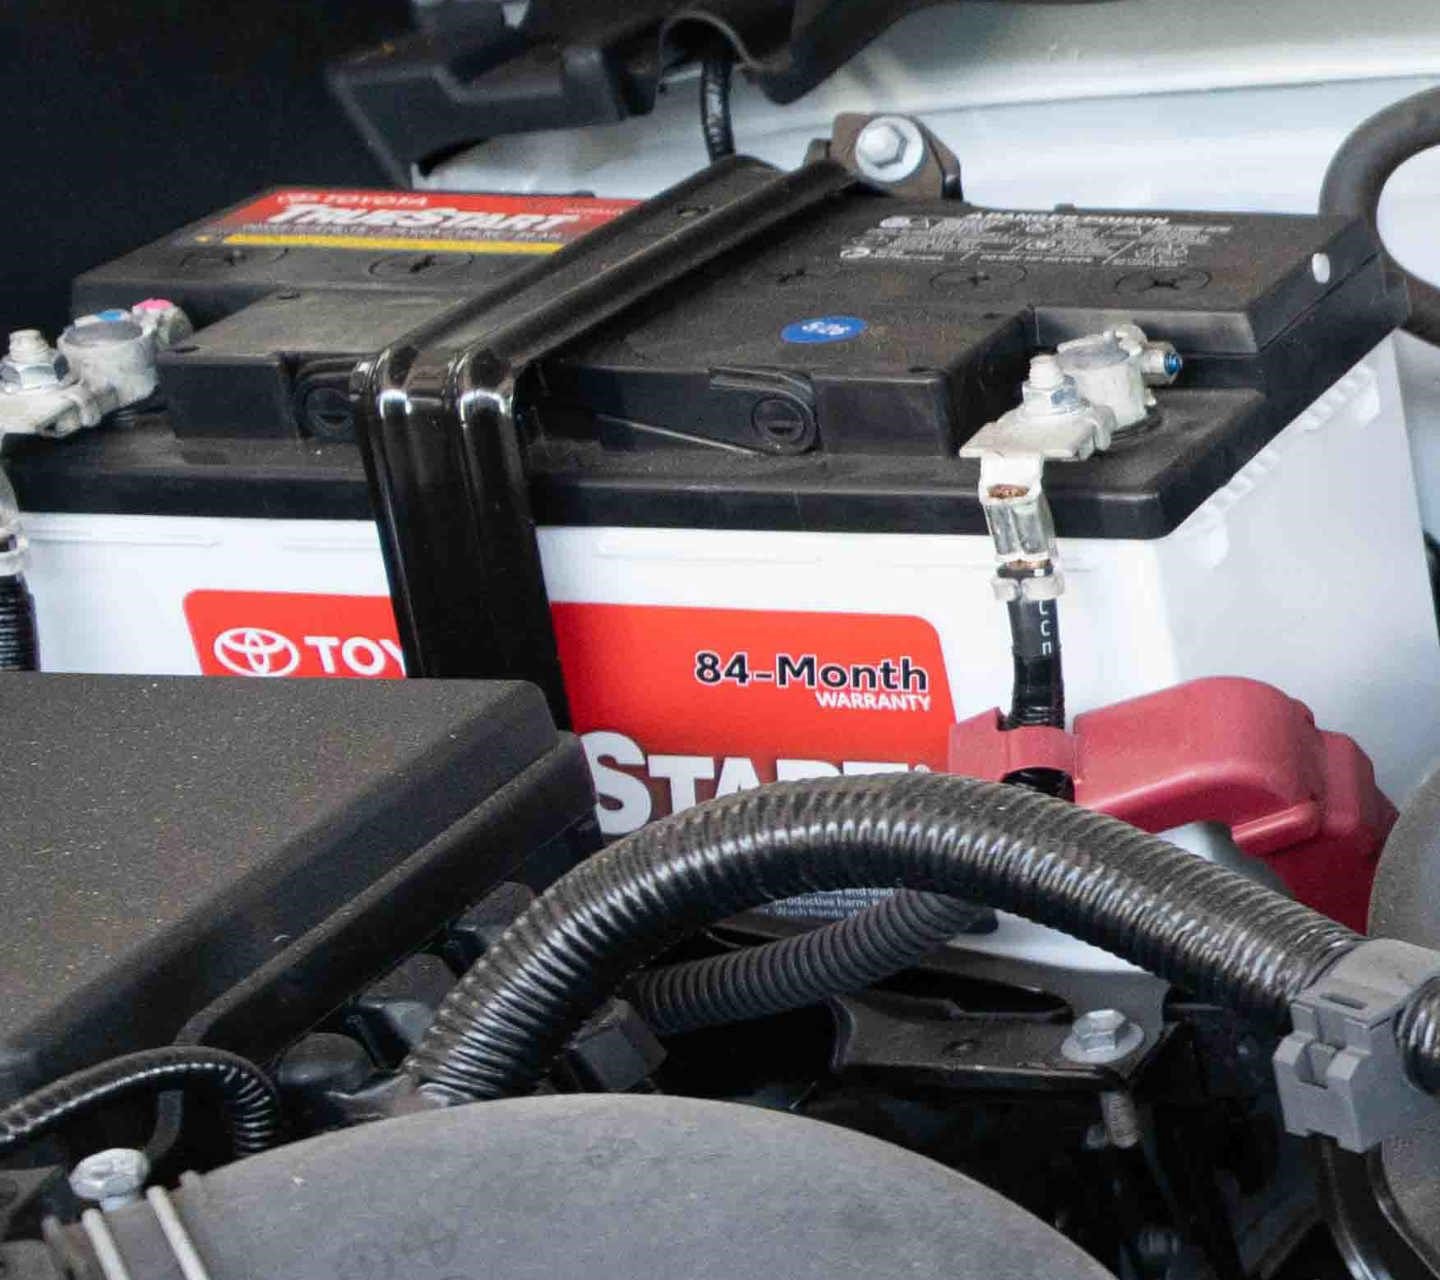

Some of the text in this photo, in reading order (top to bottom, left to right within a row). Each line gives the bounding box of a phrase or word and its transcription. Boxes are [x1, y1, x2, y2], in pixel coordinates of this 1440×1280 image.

[324, 195, 428, 207] TOYOTA
[695, 650, 929, 693] 84-Month
[815, 691, 931, 712] WARRANTY
